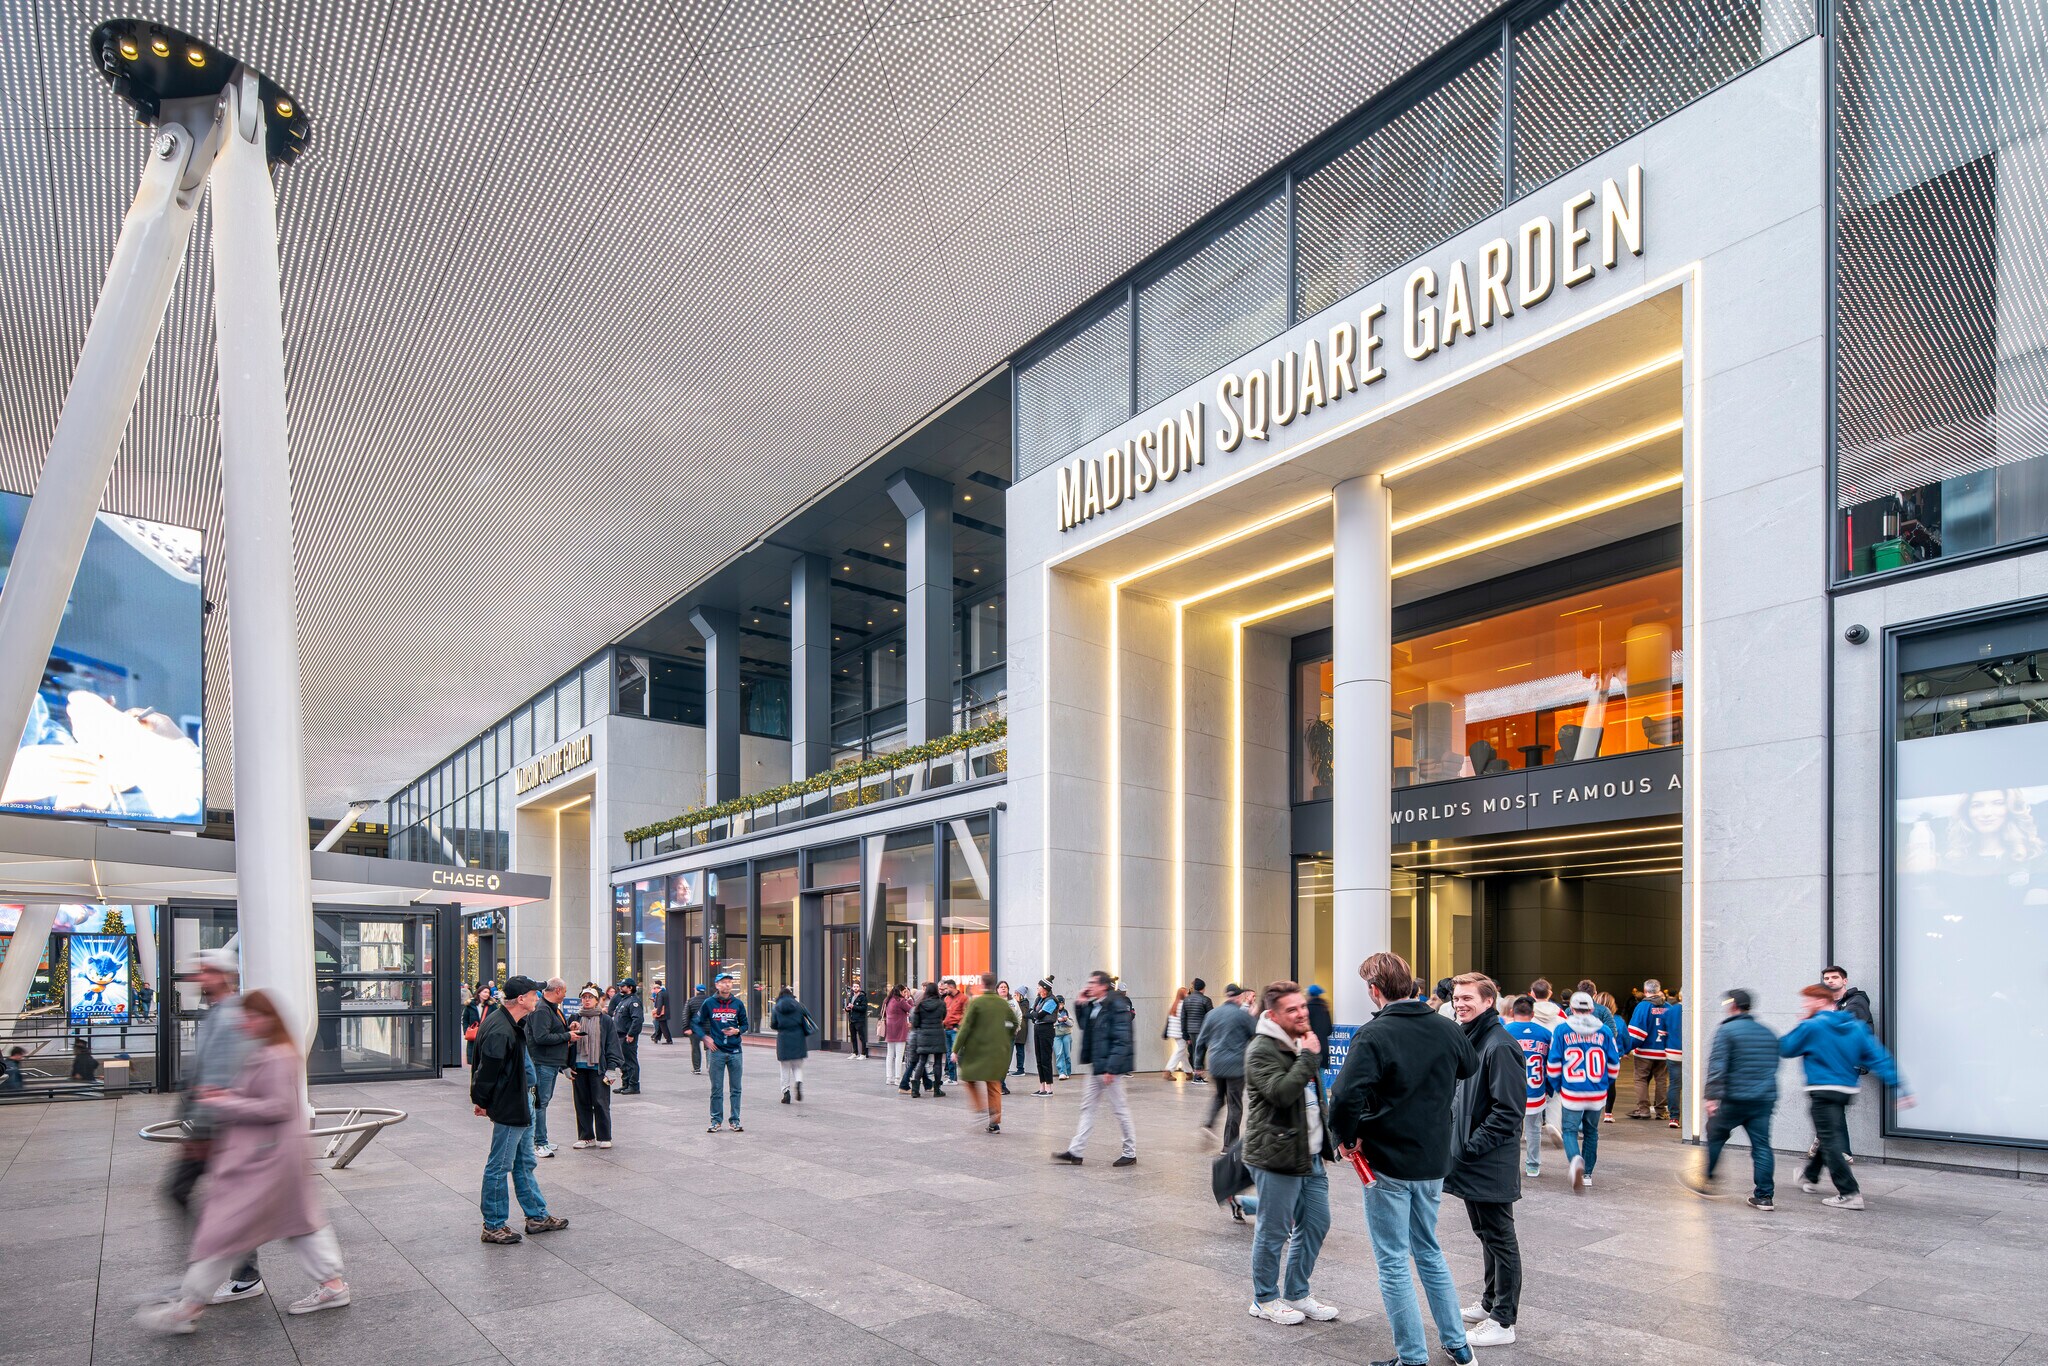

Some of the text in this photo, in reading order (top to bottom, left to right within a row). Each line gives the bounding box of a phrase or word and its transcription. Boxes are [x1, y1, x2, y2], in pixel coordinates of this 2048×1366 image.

[1057, 163, 1644, 532] MADISON SQUARE GARDEN
[515, 733, 592, 795] MADISON SQUARE GARDEN
[1391, 801, 1472, 825] WORLD'S
[1483, 792, 1540, 813] MOST
[1553, 777, 1652, 805] FAMOUS
[432, 870, 485, 888] CHASE
[472, 916, 488, 930] CHASE
[73, 1003, 126, 1014] SONIC 3
[1334, 1031, 1350, 1039] GARDEN
[1563, 1046, 1606, 1084] 20
